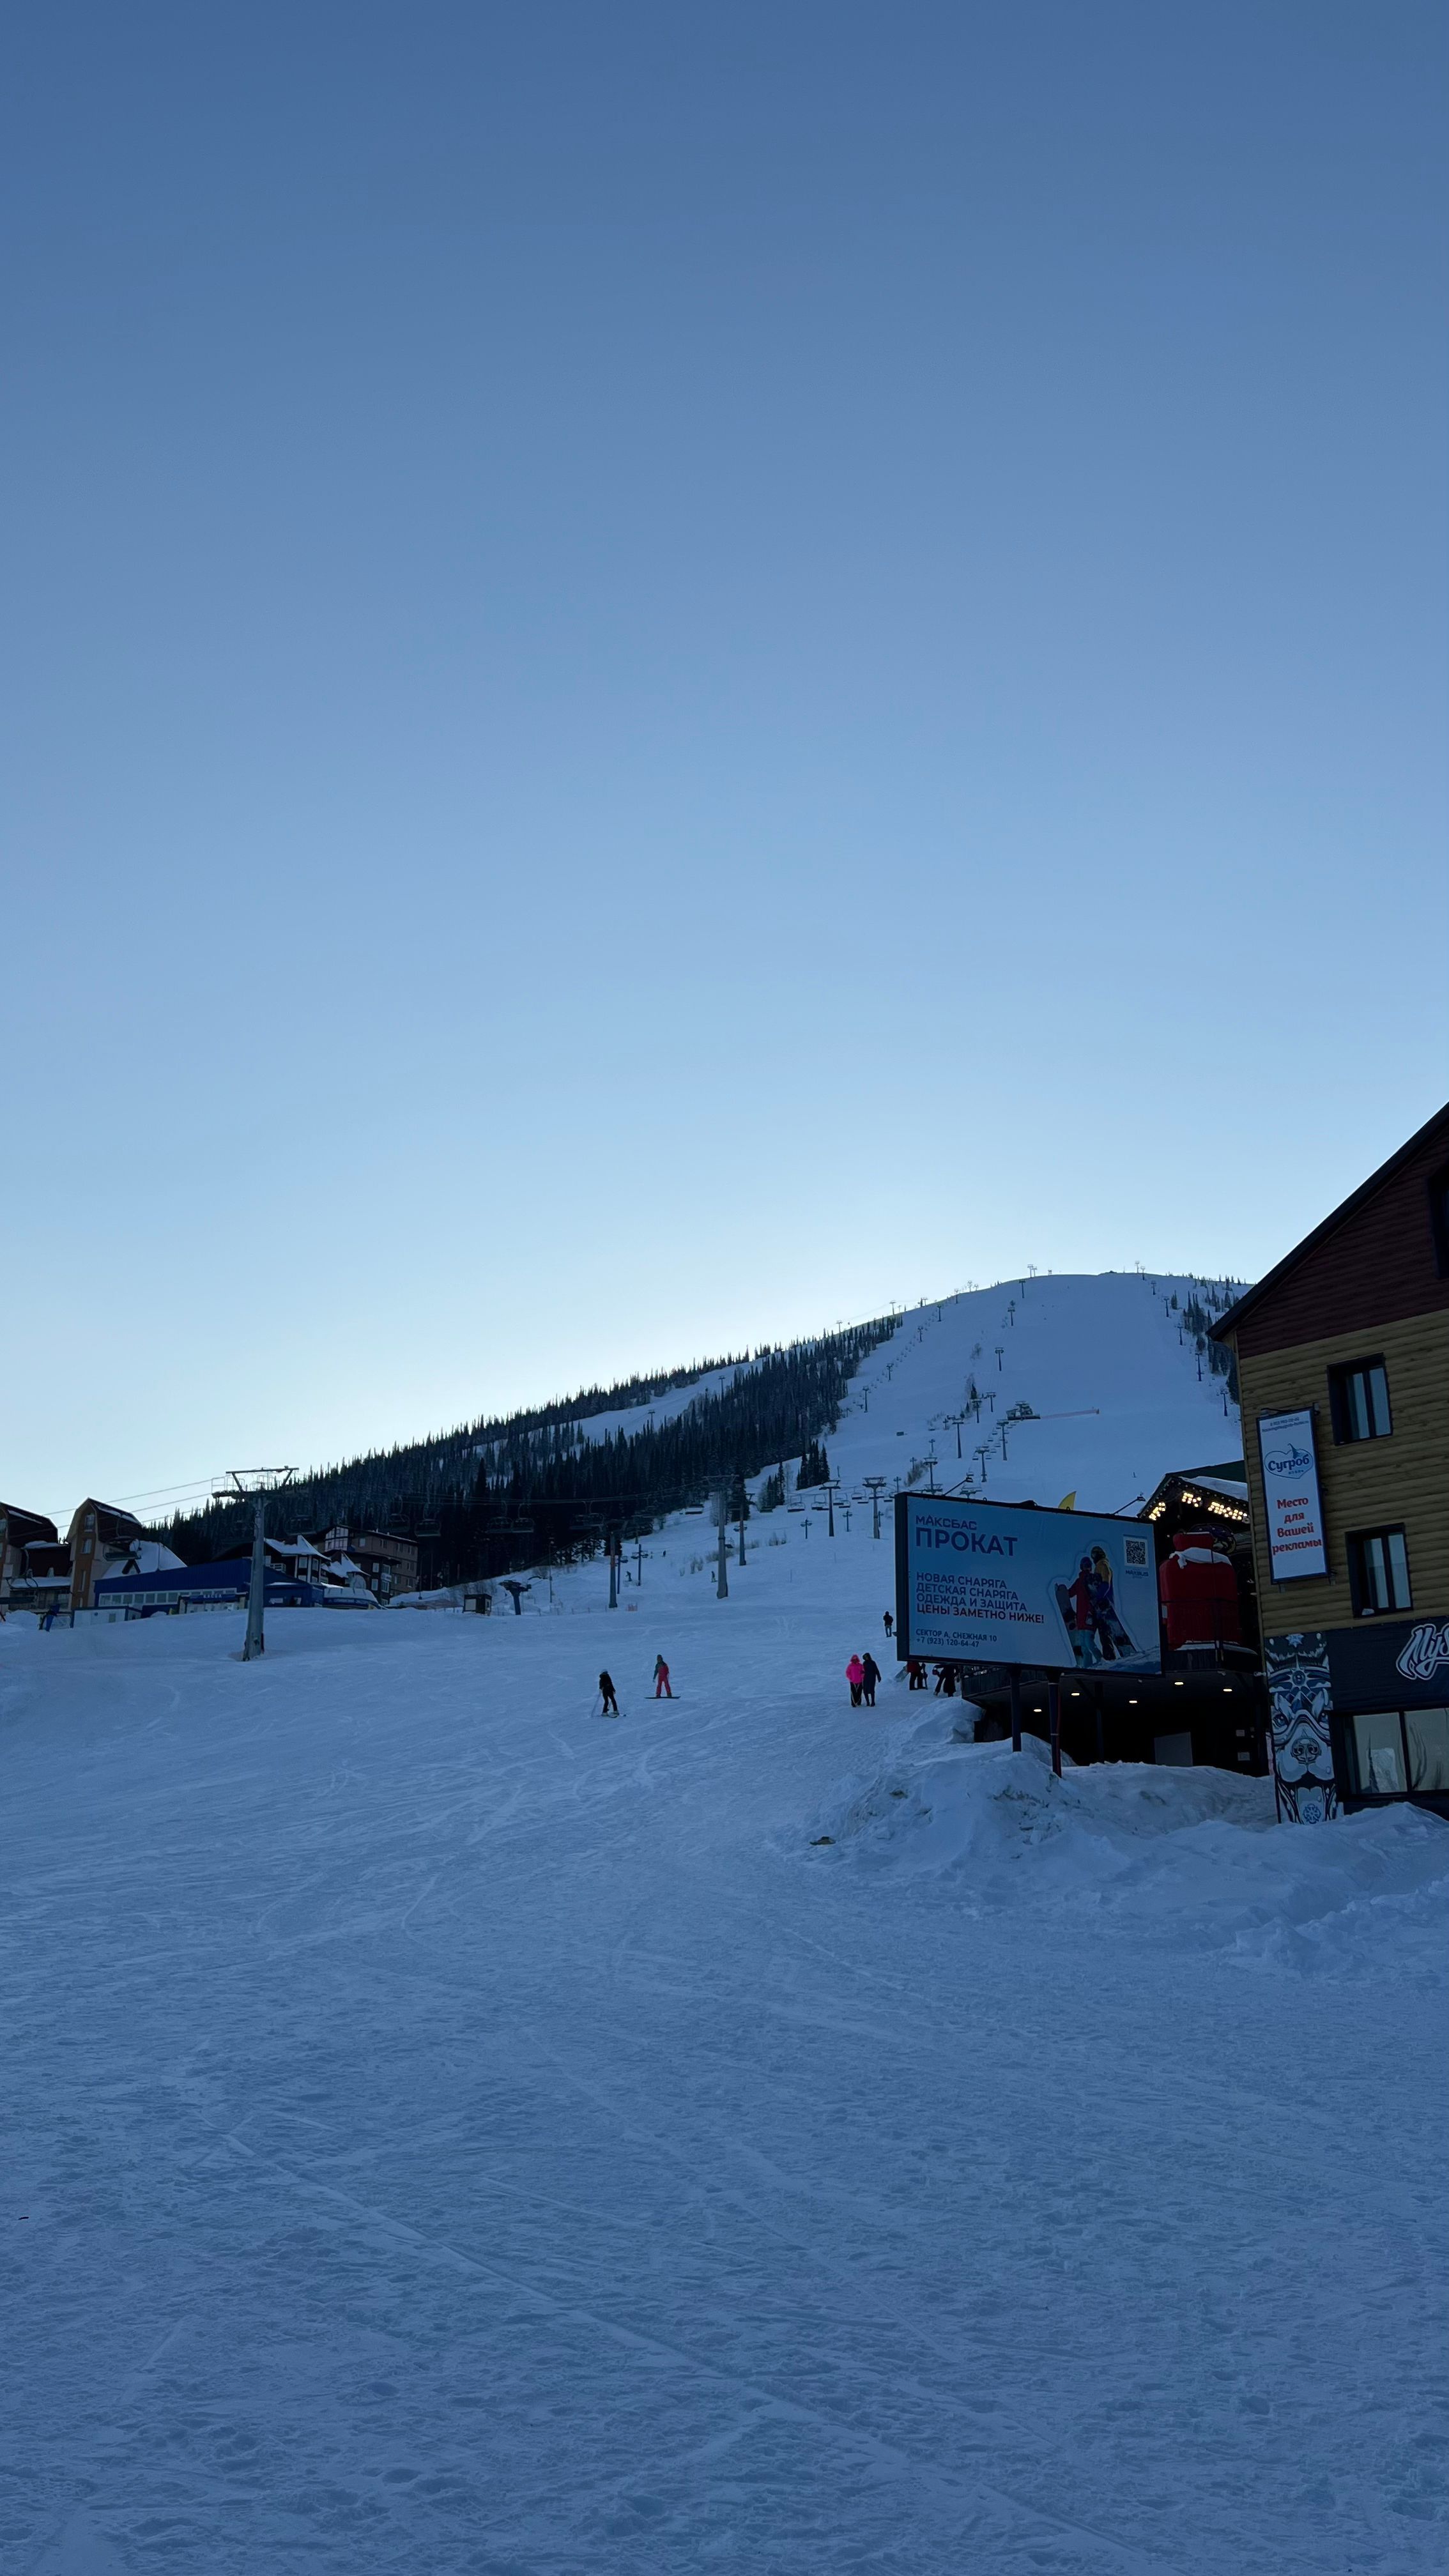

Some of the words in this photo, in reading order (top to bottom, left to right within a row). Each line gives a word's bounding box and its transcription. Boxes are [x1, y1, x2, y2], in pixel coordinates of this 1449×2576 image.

[1268, 1453, 1310, 1473] Сугроб
[1276, 1498, 1308, 1509] Место
[916, 1515, 977, 1530] МАКСБАС
[1284, 1512, 1305, 1524] для
[1277, 1522, 1314, 1538] Вашей
[916, 1526, 1018, 1556] ПРОКАТ
[1272, 1538, 1322, 1555] рекламы
[916, 1572, 954, 1584] НОВАЯ
[958, 1575, 1008, 1589] СНАРЯГА
[916, 1583, 966, 1595] ДЕТСКАЯ
[969, 1588, 1018, 1600] СНАРЯГА
[916, 1593, 967, 1606] ОДЕЖДА
[969, 1598, 977, 1607] И
[980, 1598, 1027, 1611] ЗАЩИТА
[917, 1604, 950, 1615] ЦЕНЫ
[953, 1607, 1006, 1620] ЗАМЕТНО
[1009, 1613, 1045, 1623] НИЖЕ!
[916, 1629, 942, 1637] СЕКТОР
[952, 1632, 987, 1641] СНЕЖНАЯ
[927, 1637, 944, 1646] (923)
[946, 1639, 979, 1648] 120-64-47
